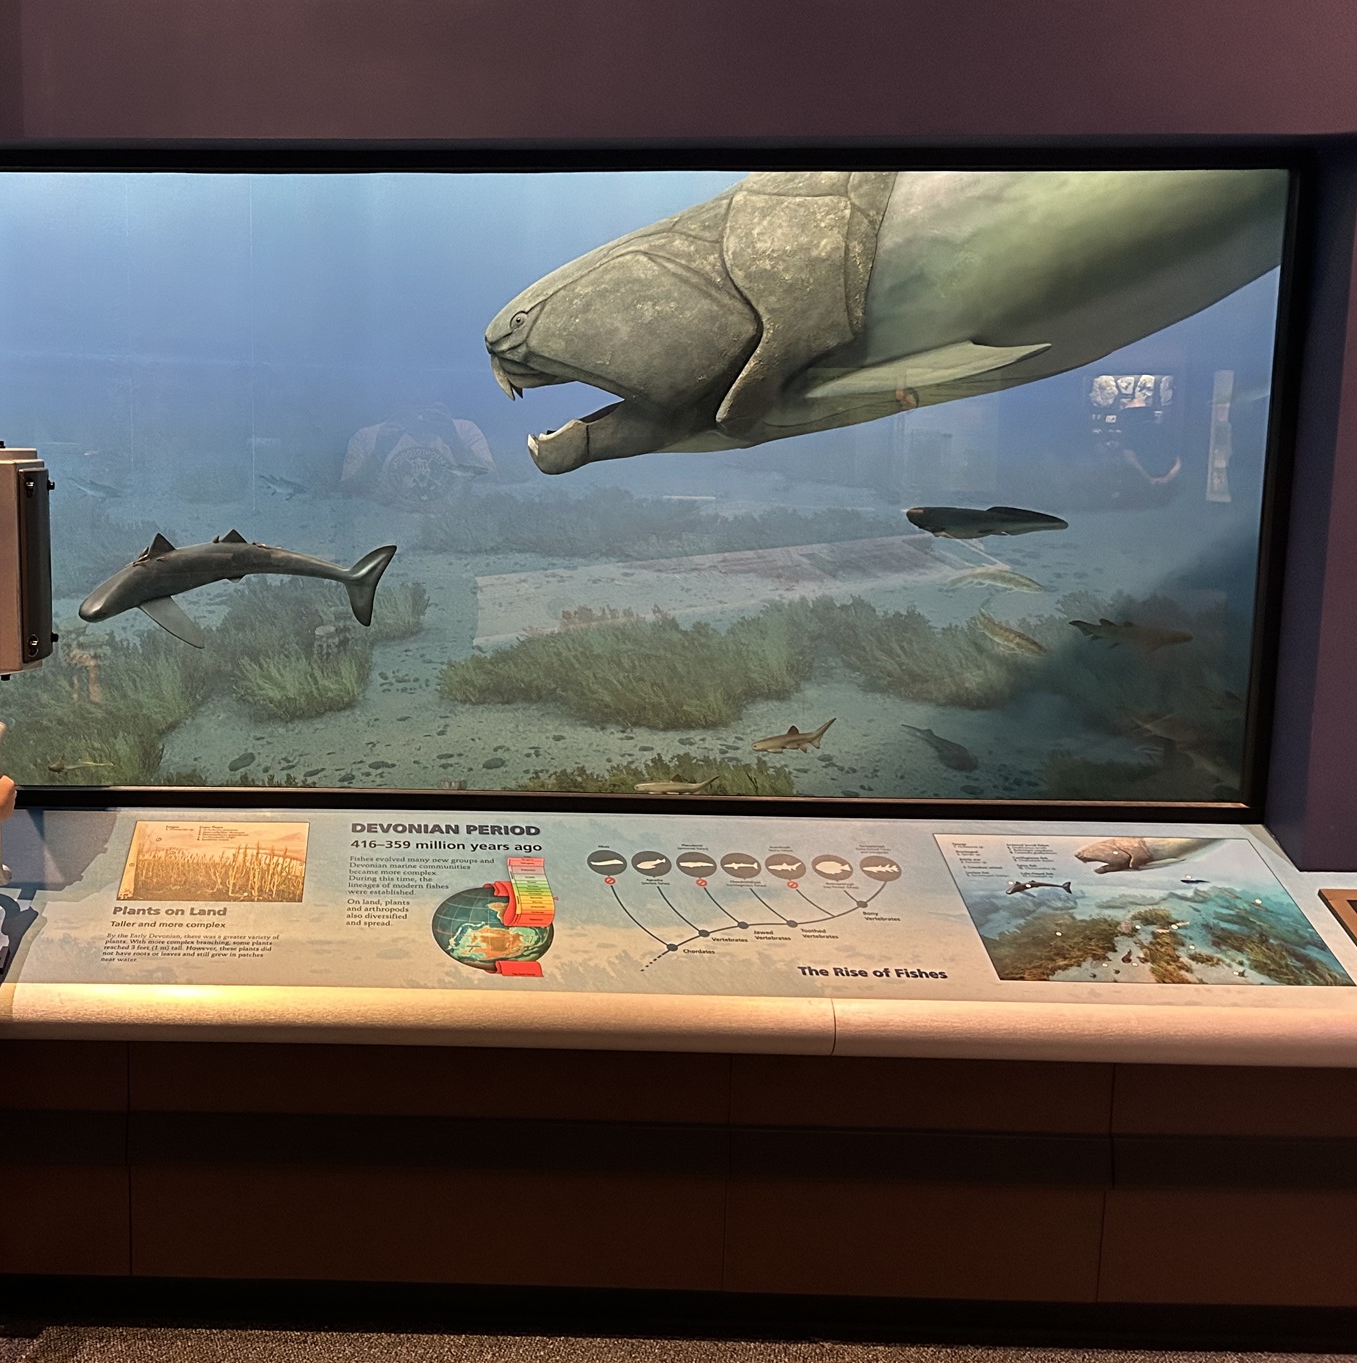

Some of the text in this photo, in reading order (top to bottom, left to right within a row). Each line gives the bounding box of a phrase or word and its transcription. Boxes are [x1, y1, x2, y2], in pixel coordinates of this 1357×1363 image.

[352, 823, 540, 835] DEVONIAN PERIOD
[416, 841, 465, 850] million
[471, 843, 509, 852] years
[515, 844, 542, 852] ago
[112, 907, 160, 915] Plants
[189, 907, 227, 916] Land
[798, 966, 948, 978] The Rise of Fishes
